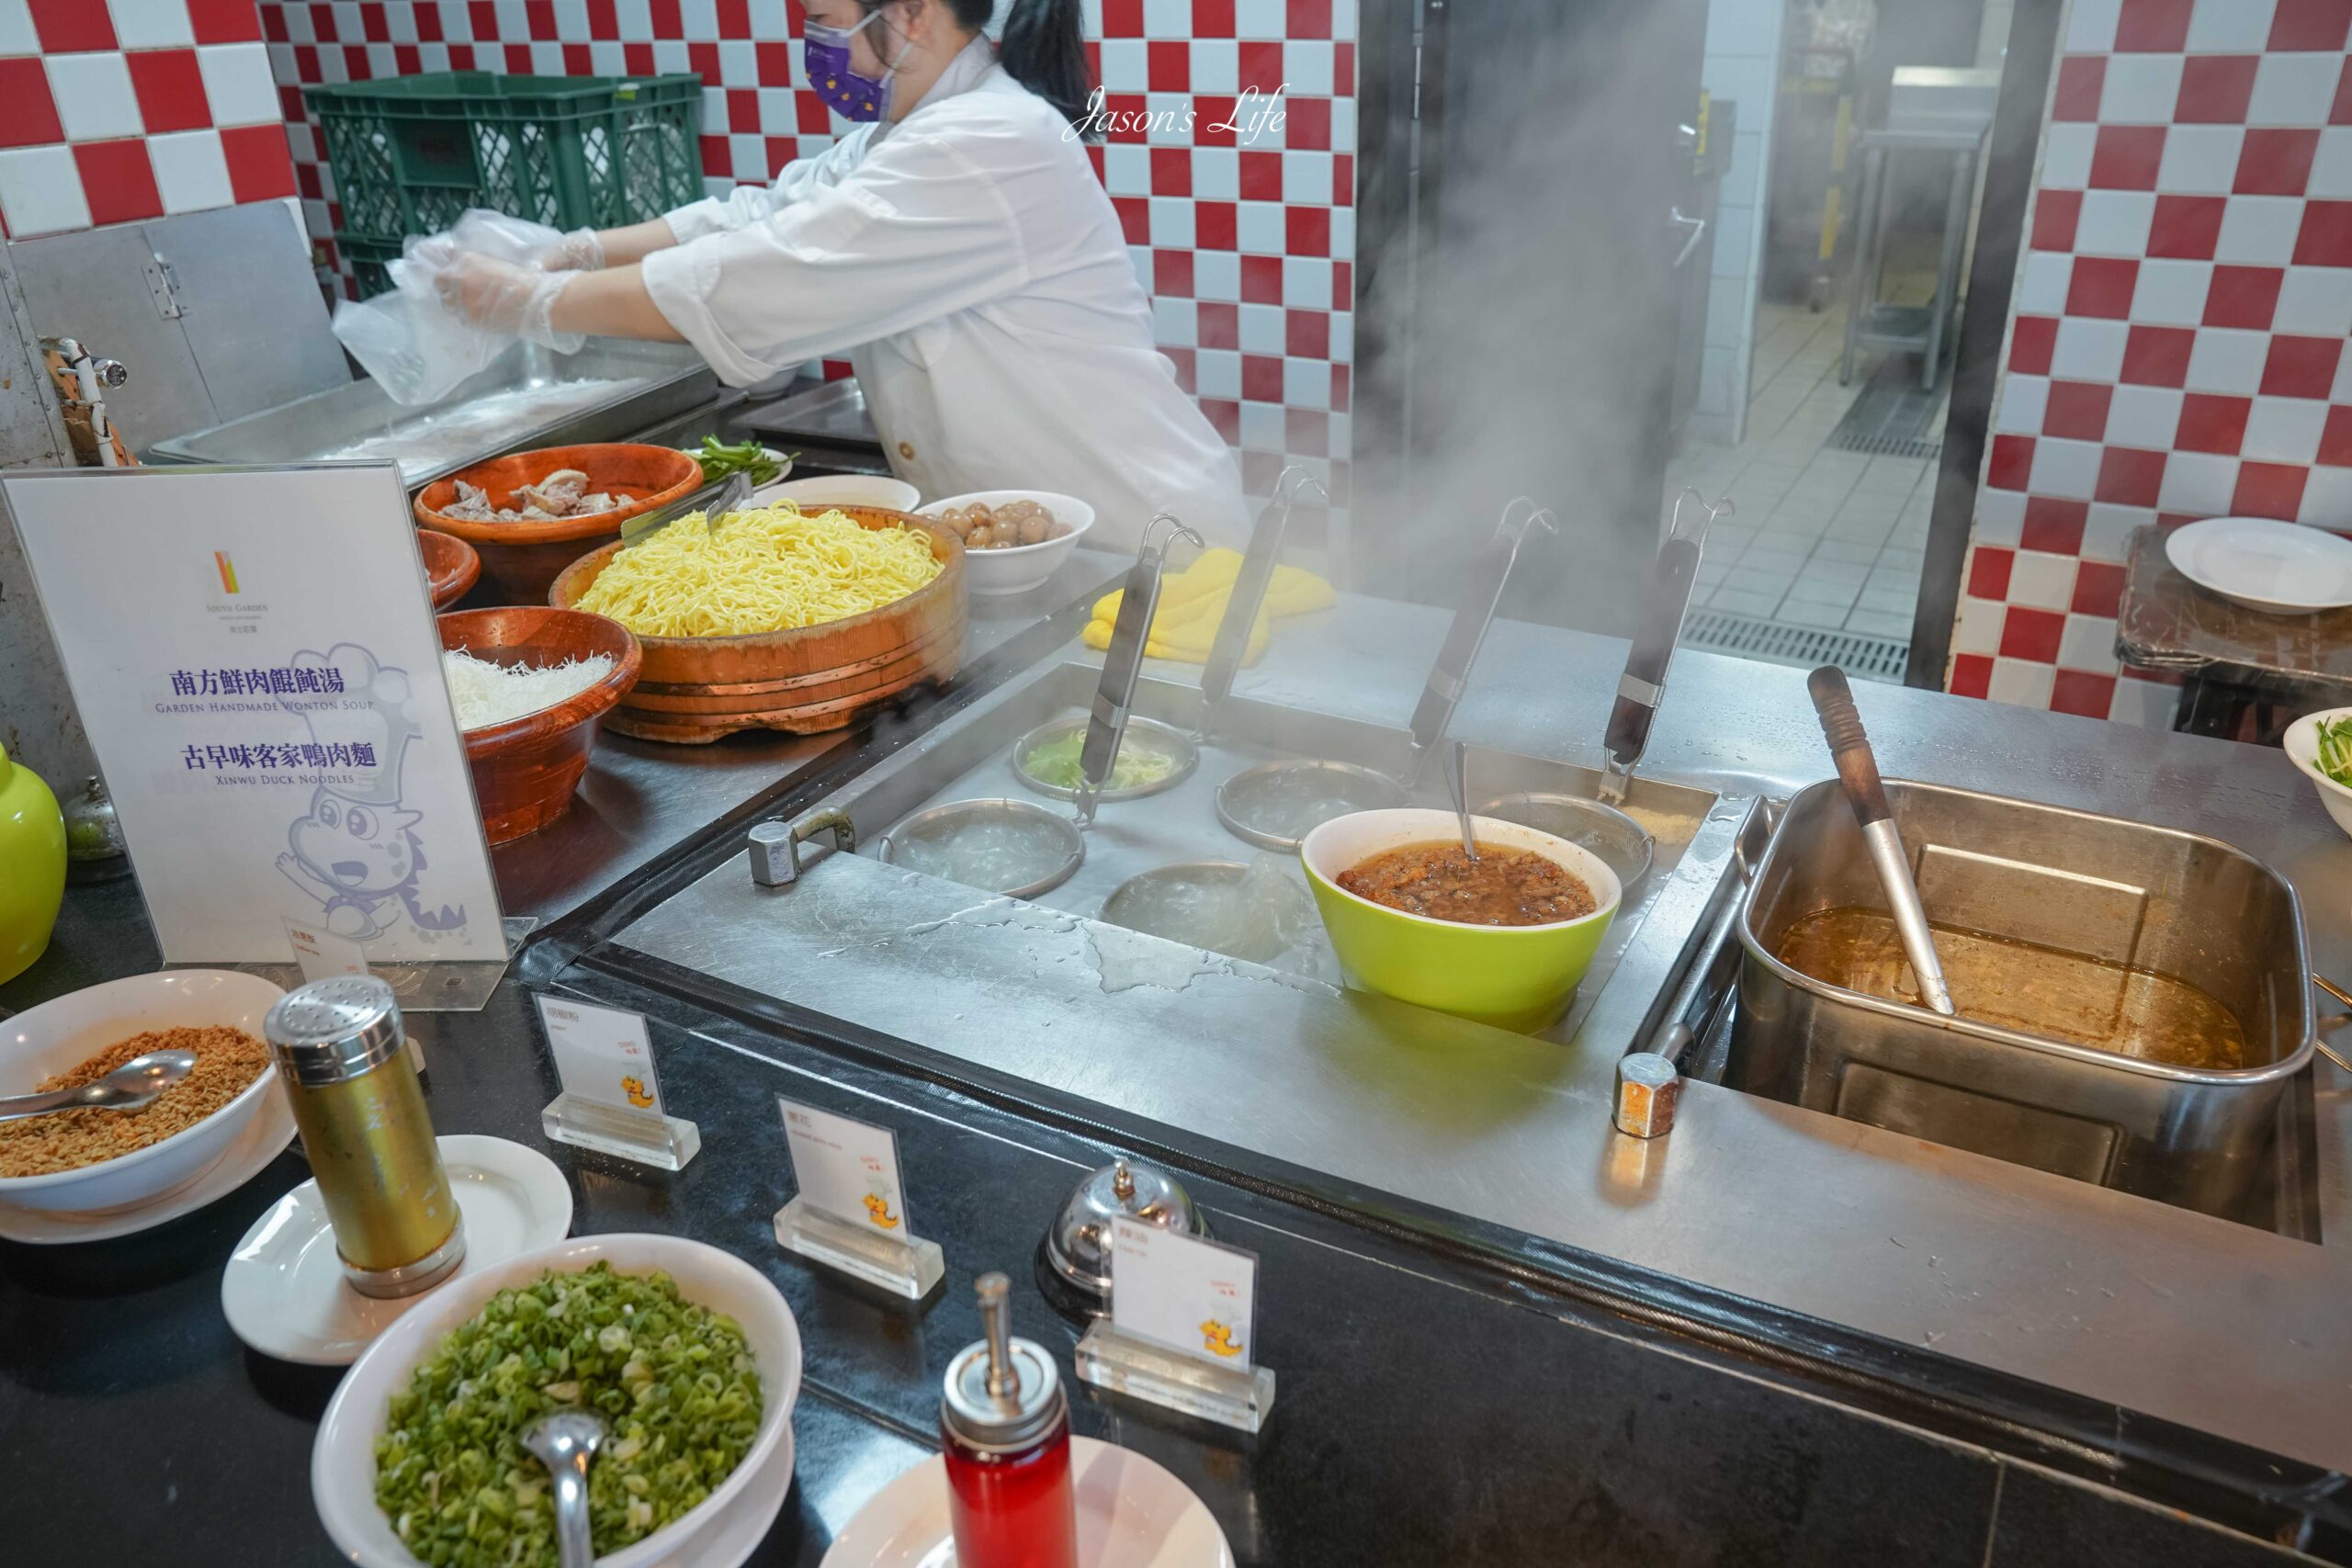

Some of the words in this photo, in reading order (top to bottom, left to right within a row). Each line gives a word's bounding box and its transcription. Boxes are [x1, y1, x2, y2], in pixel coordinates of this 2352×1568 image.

[169, 667, 345, 695] 南方鮮肉餛飩湯
[155, 703, 204, 714] GARDEN
[210, 702, 278, 713] HANDMADE
[281, 700, 338, 712] WONTON
[343, 700, 374, 710] SOUP
[181, 741, 378, 770] 古早味客家鴨肉麵
[216, 775, 256, 785] XINWU
[261, 774, 295, 785] DUCK
[300, 773, 355, 784] NOODLES
